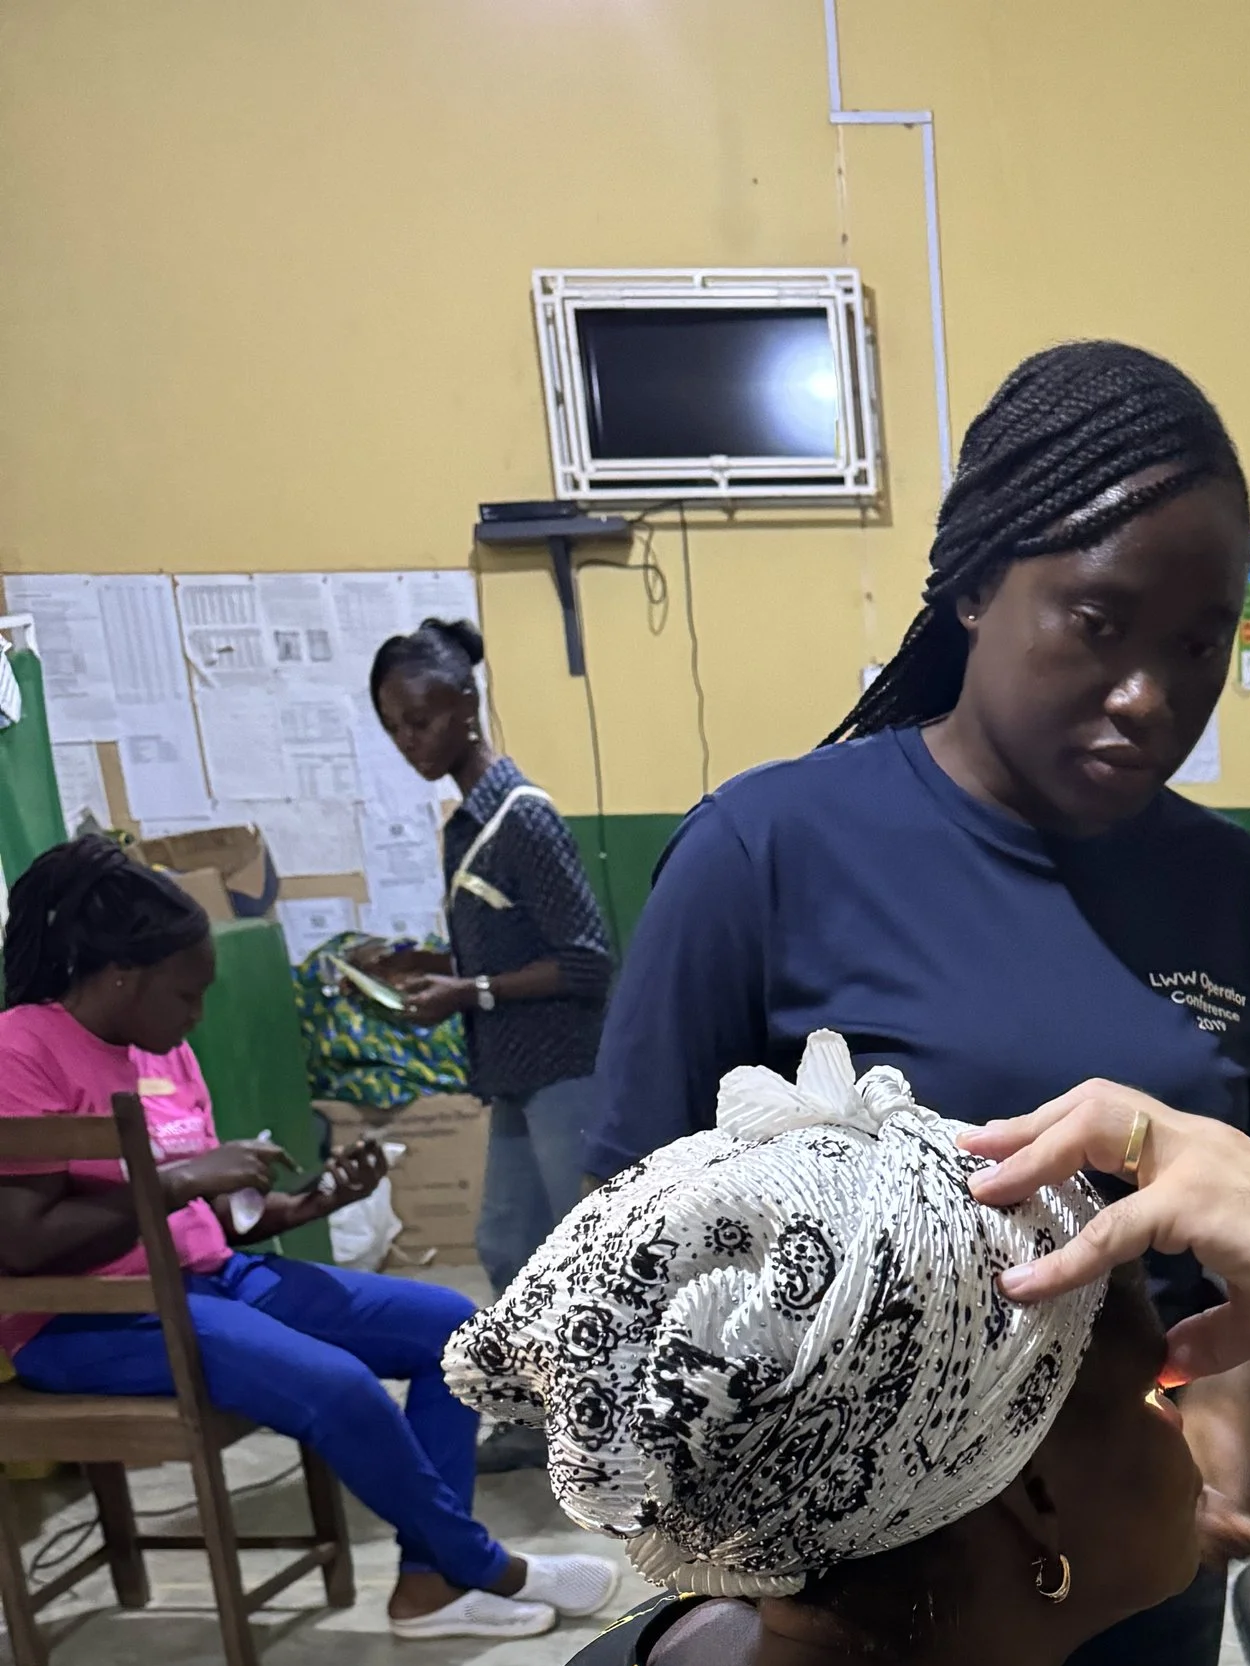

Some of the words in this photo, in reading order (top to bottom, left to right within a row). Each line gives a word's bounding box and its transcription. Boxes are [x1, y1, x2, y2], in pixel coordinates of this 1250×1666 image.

[1149, 971, 1197, 987] LWW
[1200, 972, 1247, 1007] Operator
[1170, 990, 1241, 1022] Conference
